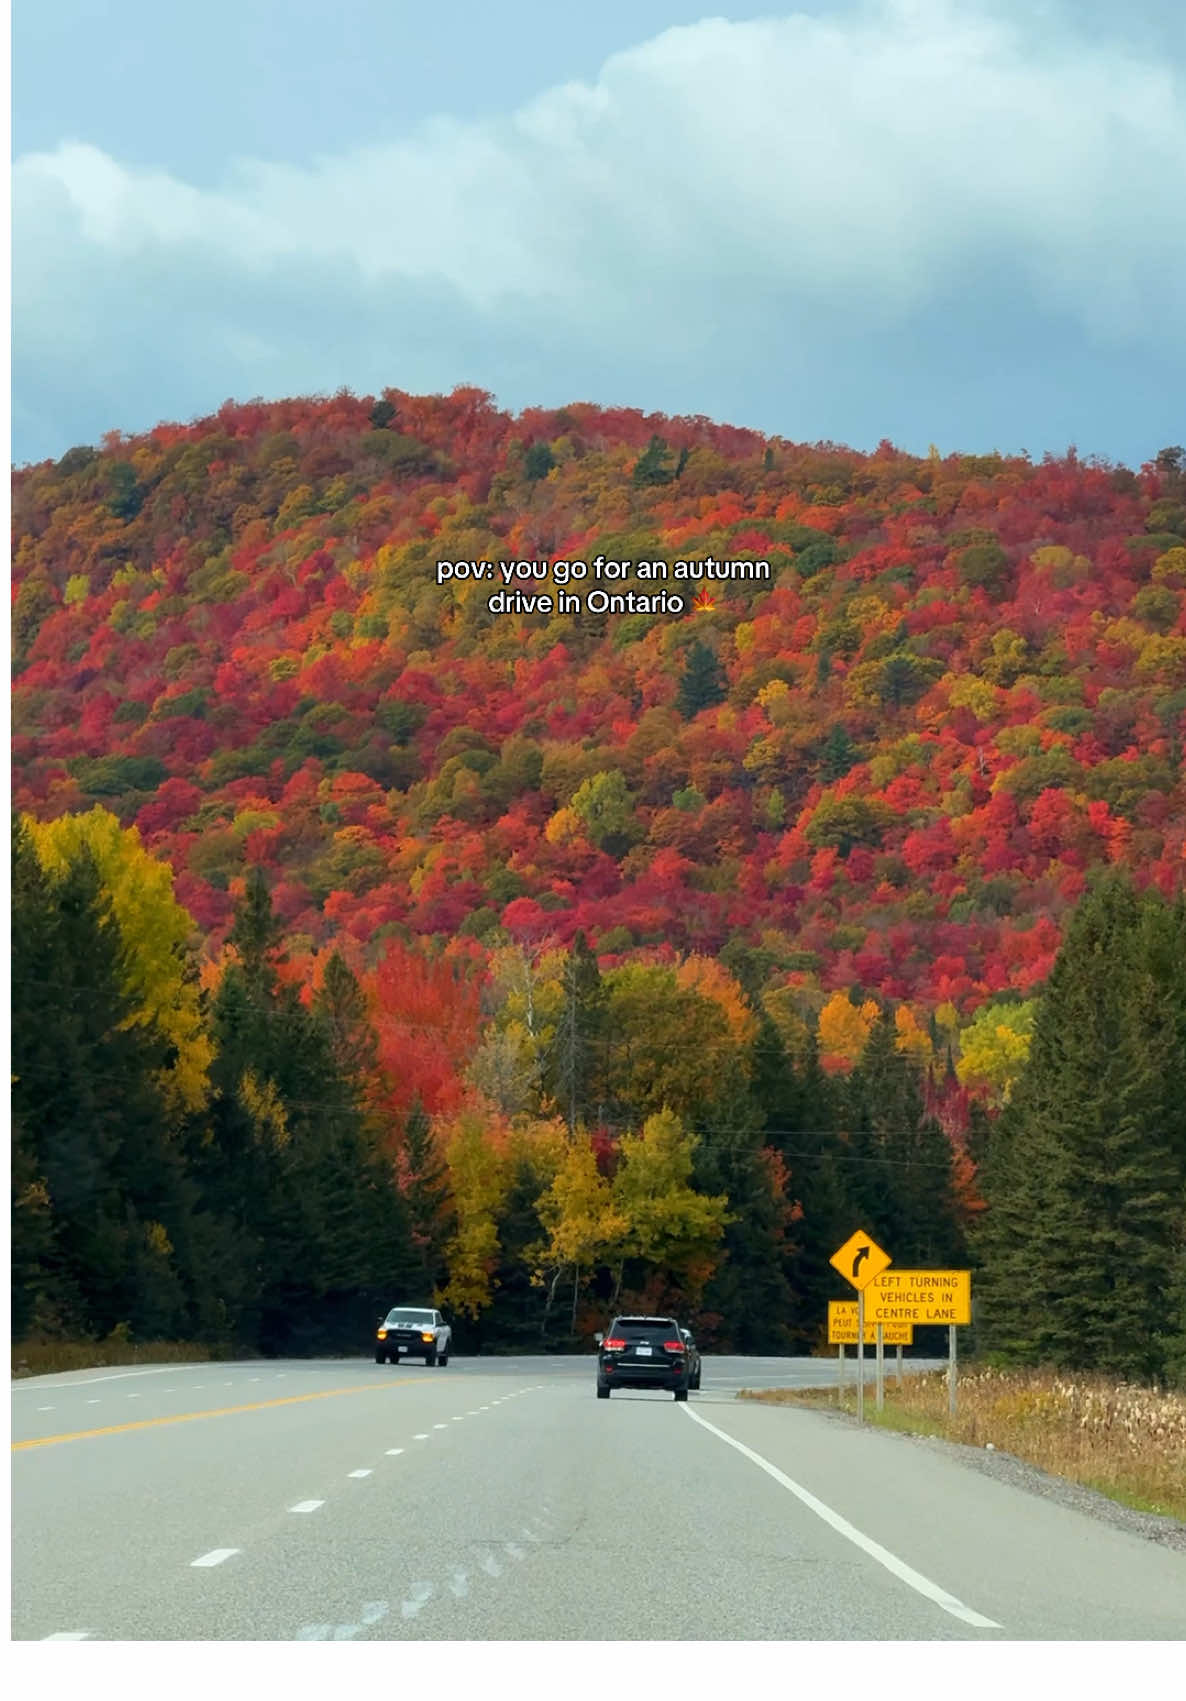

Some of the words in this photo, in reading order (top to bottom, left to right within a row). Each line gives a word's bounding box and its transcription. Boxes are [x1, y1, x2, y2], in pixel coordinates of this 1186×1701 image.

[873, 1276, 901, 1287] LEFT
[909, 1276, 959, 1288] TURNING
[880, 1291, 935, 1303] VEHICLES
[942, 1292, 953, 1303] IN
[836, 1306, 846, 1315] LA
[875, 1308, 920, 1319] CENTRE
[926, 1308, 957, 1319] LANE
[833, 1318, 852, 1328] PEUT
[832, 1330, 865, 1341] TOURN
[883, 1330, 909, 1341] AUCHE
